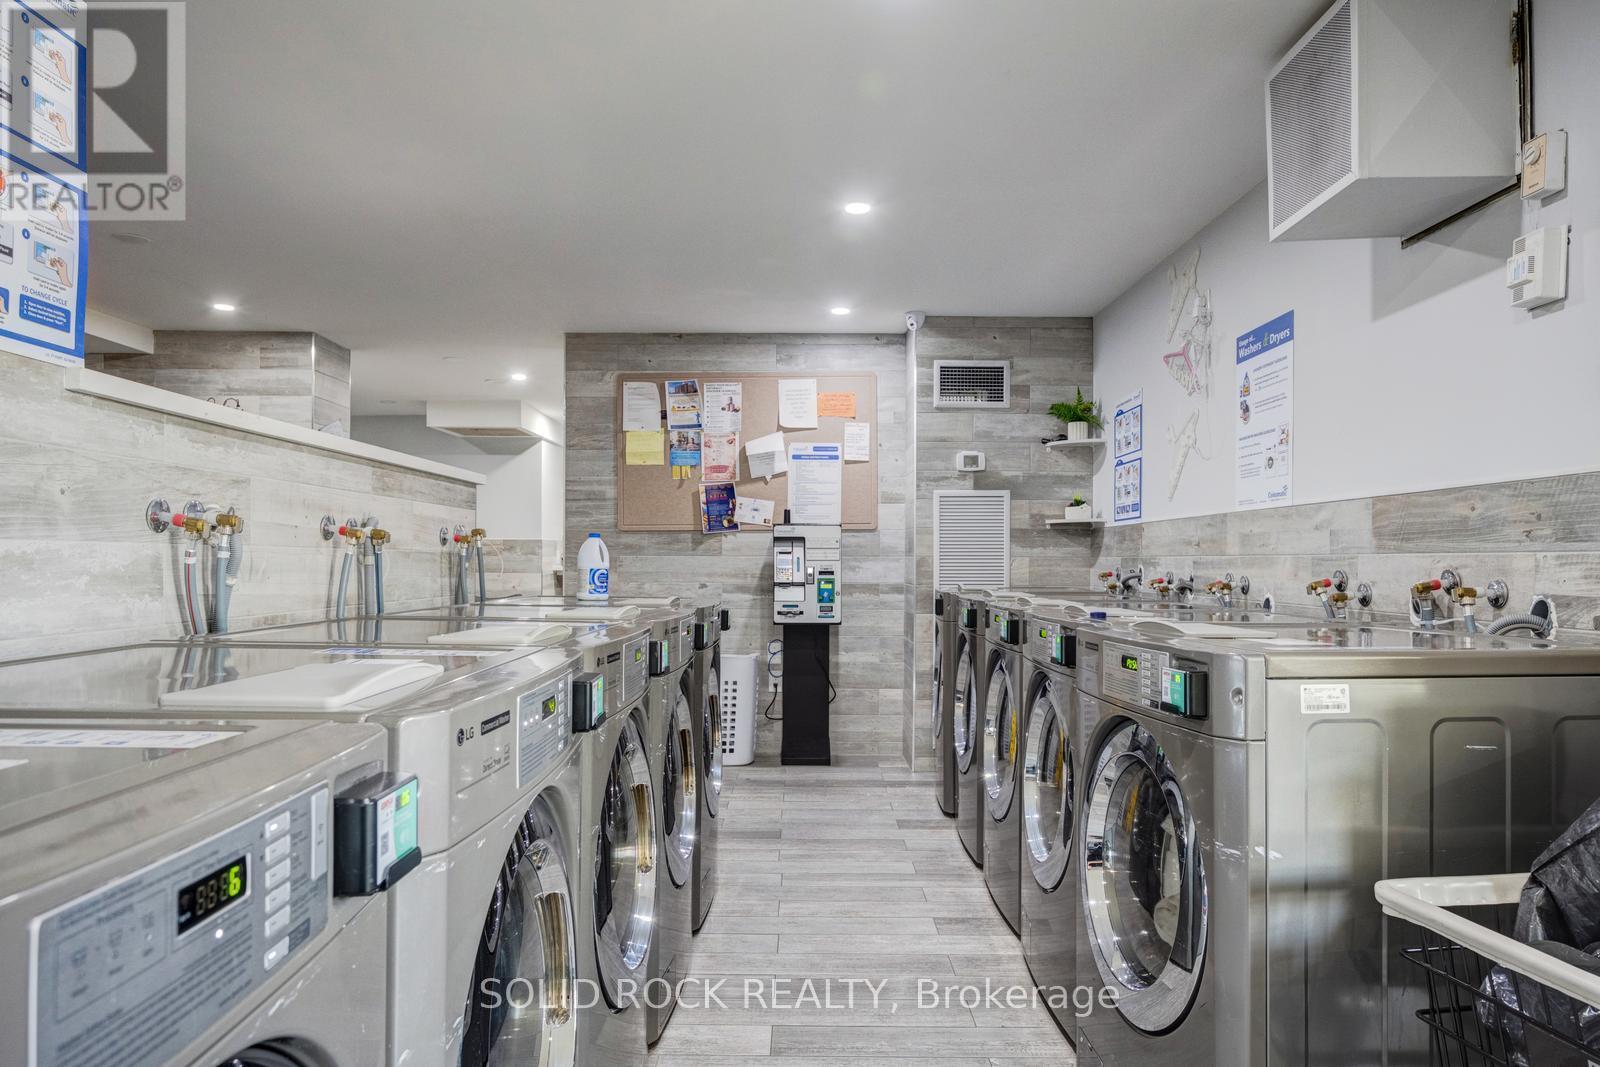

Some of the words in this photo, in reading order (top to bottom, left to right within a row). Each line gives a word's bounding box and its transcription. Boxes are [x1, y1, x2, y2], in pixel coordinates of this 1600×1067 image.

[1239, 342, 1262, 358] Washers
[1269, 328, 1290, 345] Dryers
[465, 726, 474, 740] LG
